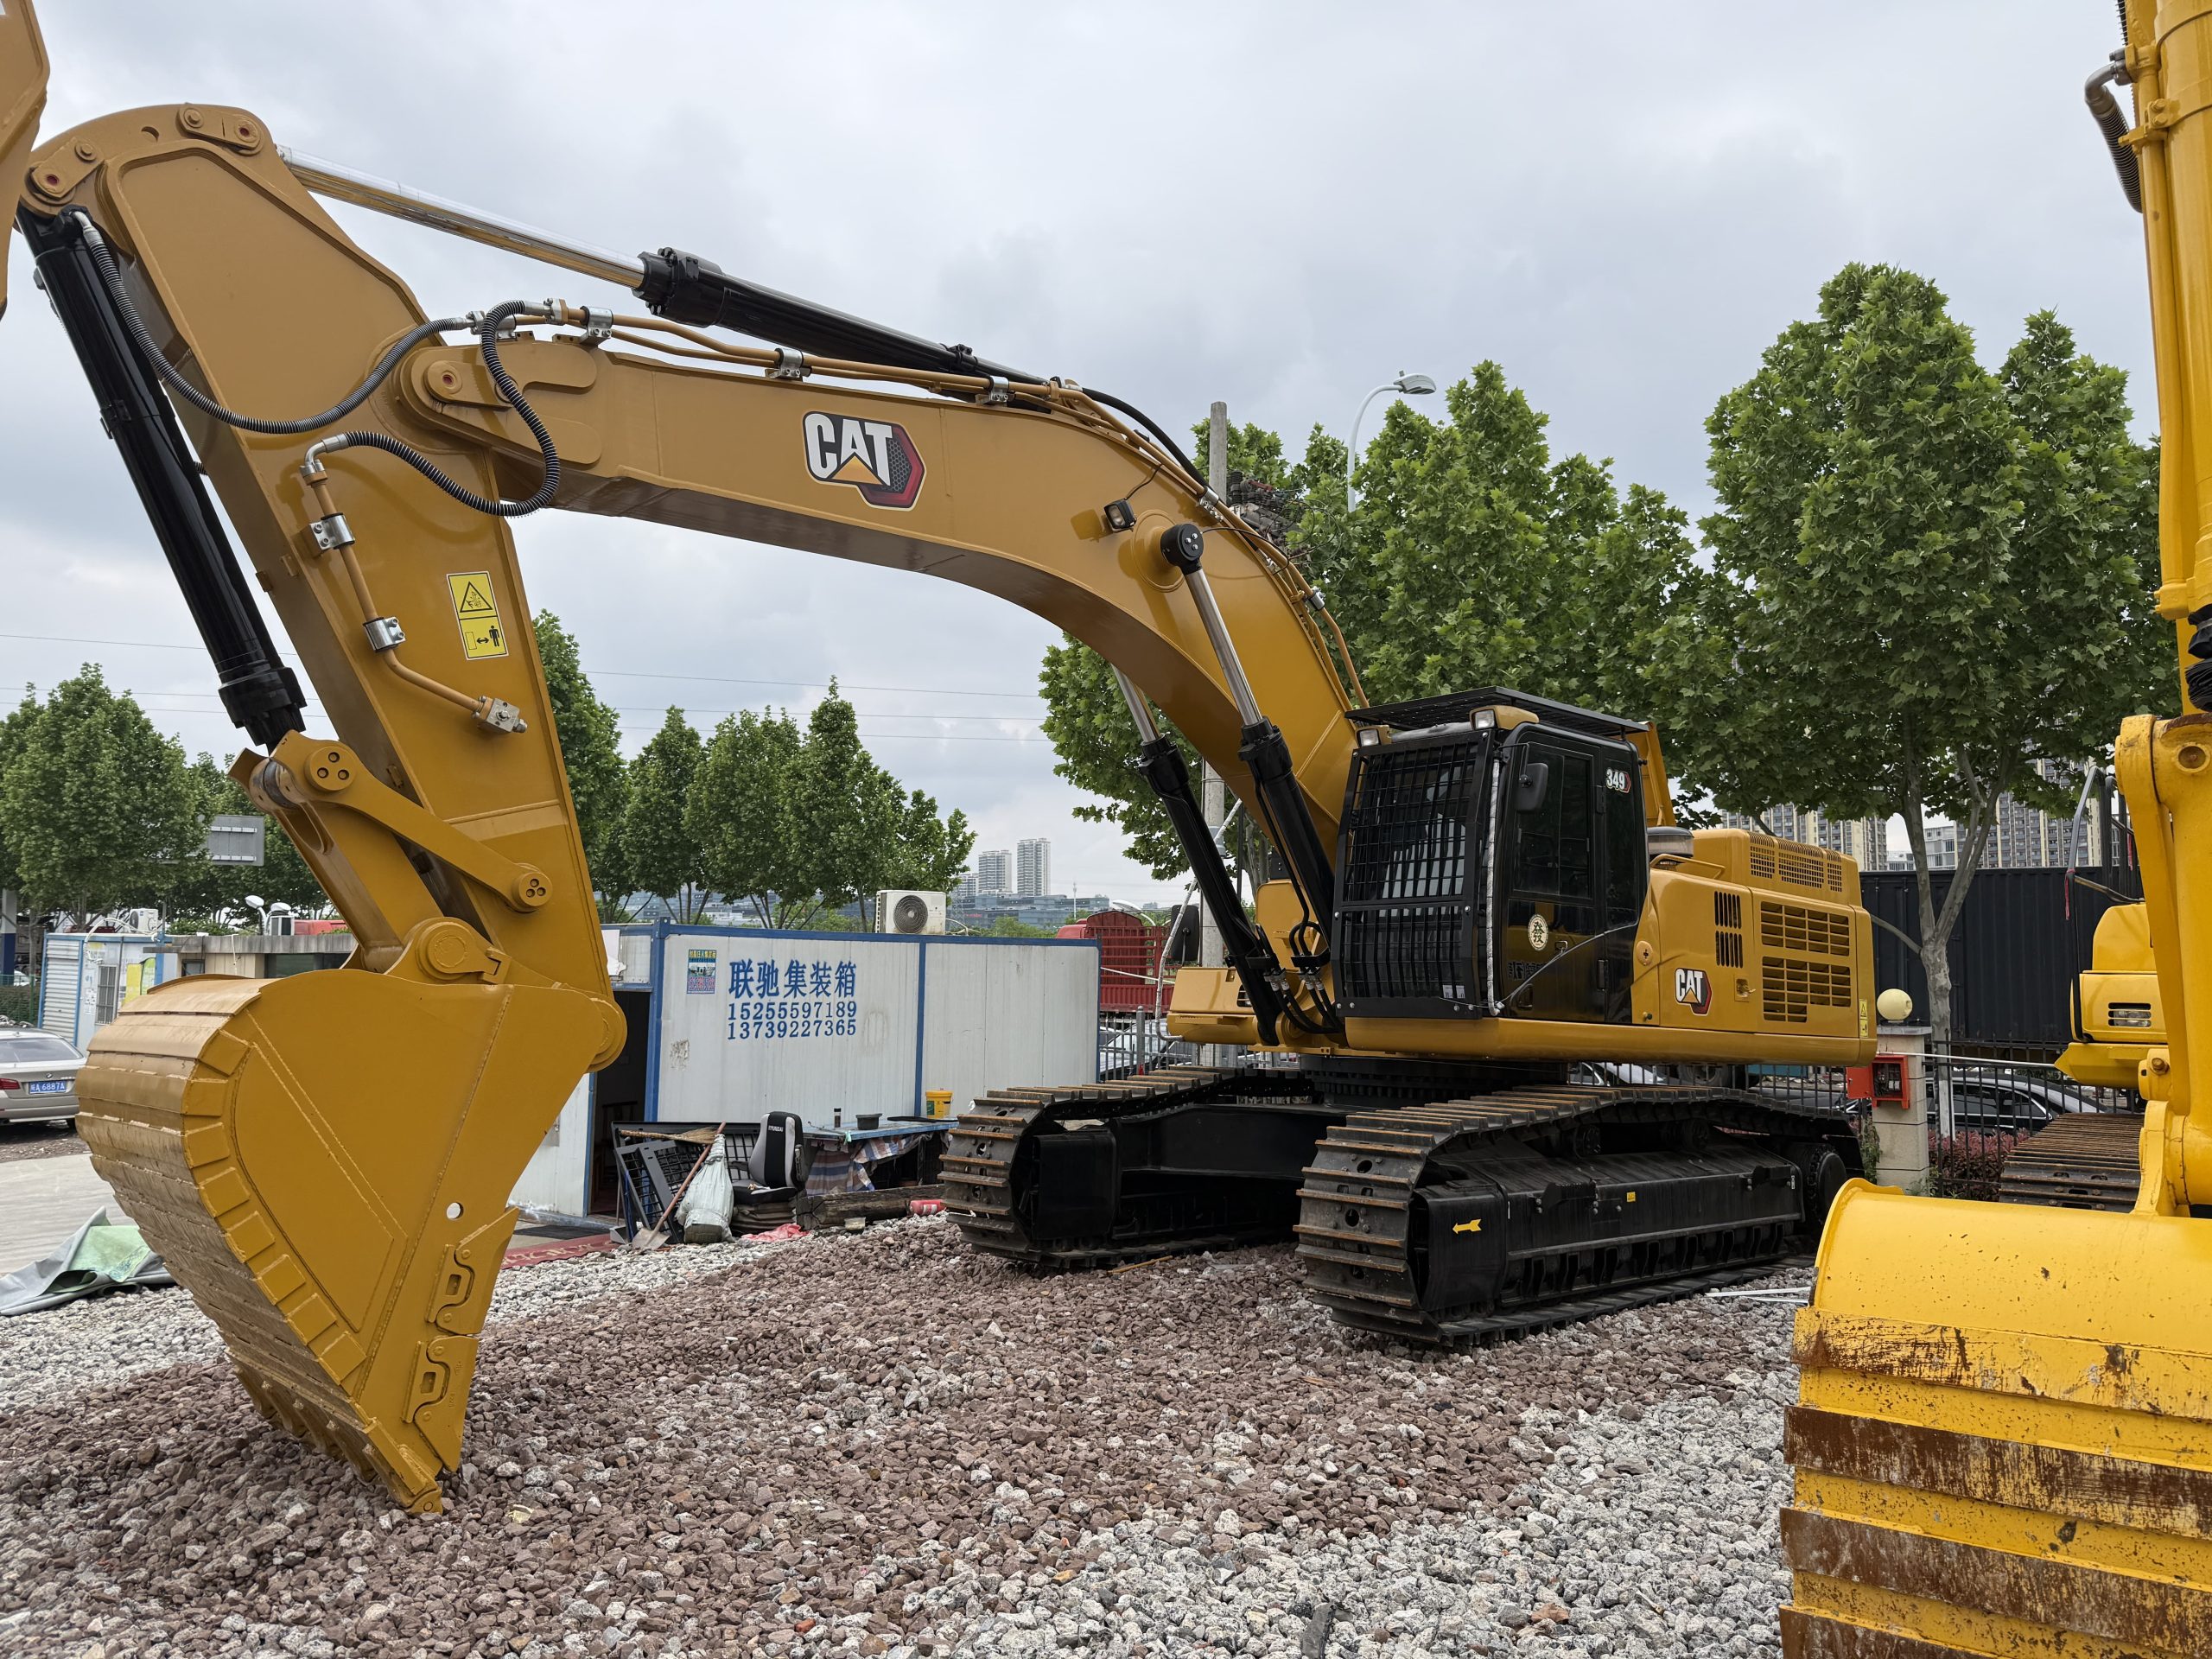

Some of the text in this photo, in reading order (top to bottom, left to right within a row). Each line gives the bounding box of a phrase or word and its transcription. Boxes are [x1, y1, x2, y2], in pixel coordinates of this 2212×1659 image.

[804, 413, 893, 486] CAT
[1605, 768, 1625, 791] 349
[1531, 921, 1546, 944] 發
[728, 958, 857, 999] 联驰集装箱
[1675, 968, 1704, 1004] CAT
[728, 1001, 857, 1020] 15255597189
[728, 1019, 856, 1039] 13739227365
